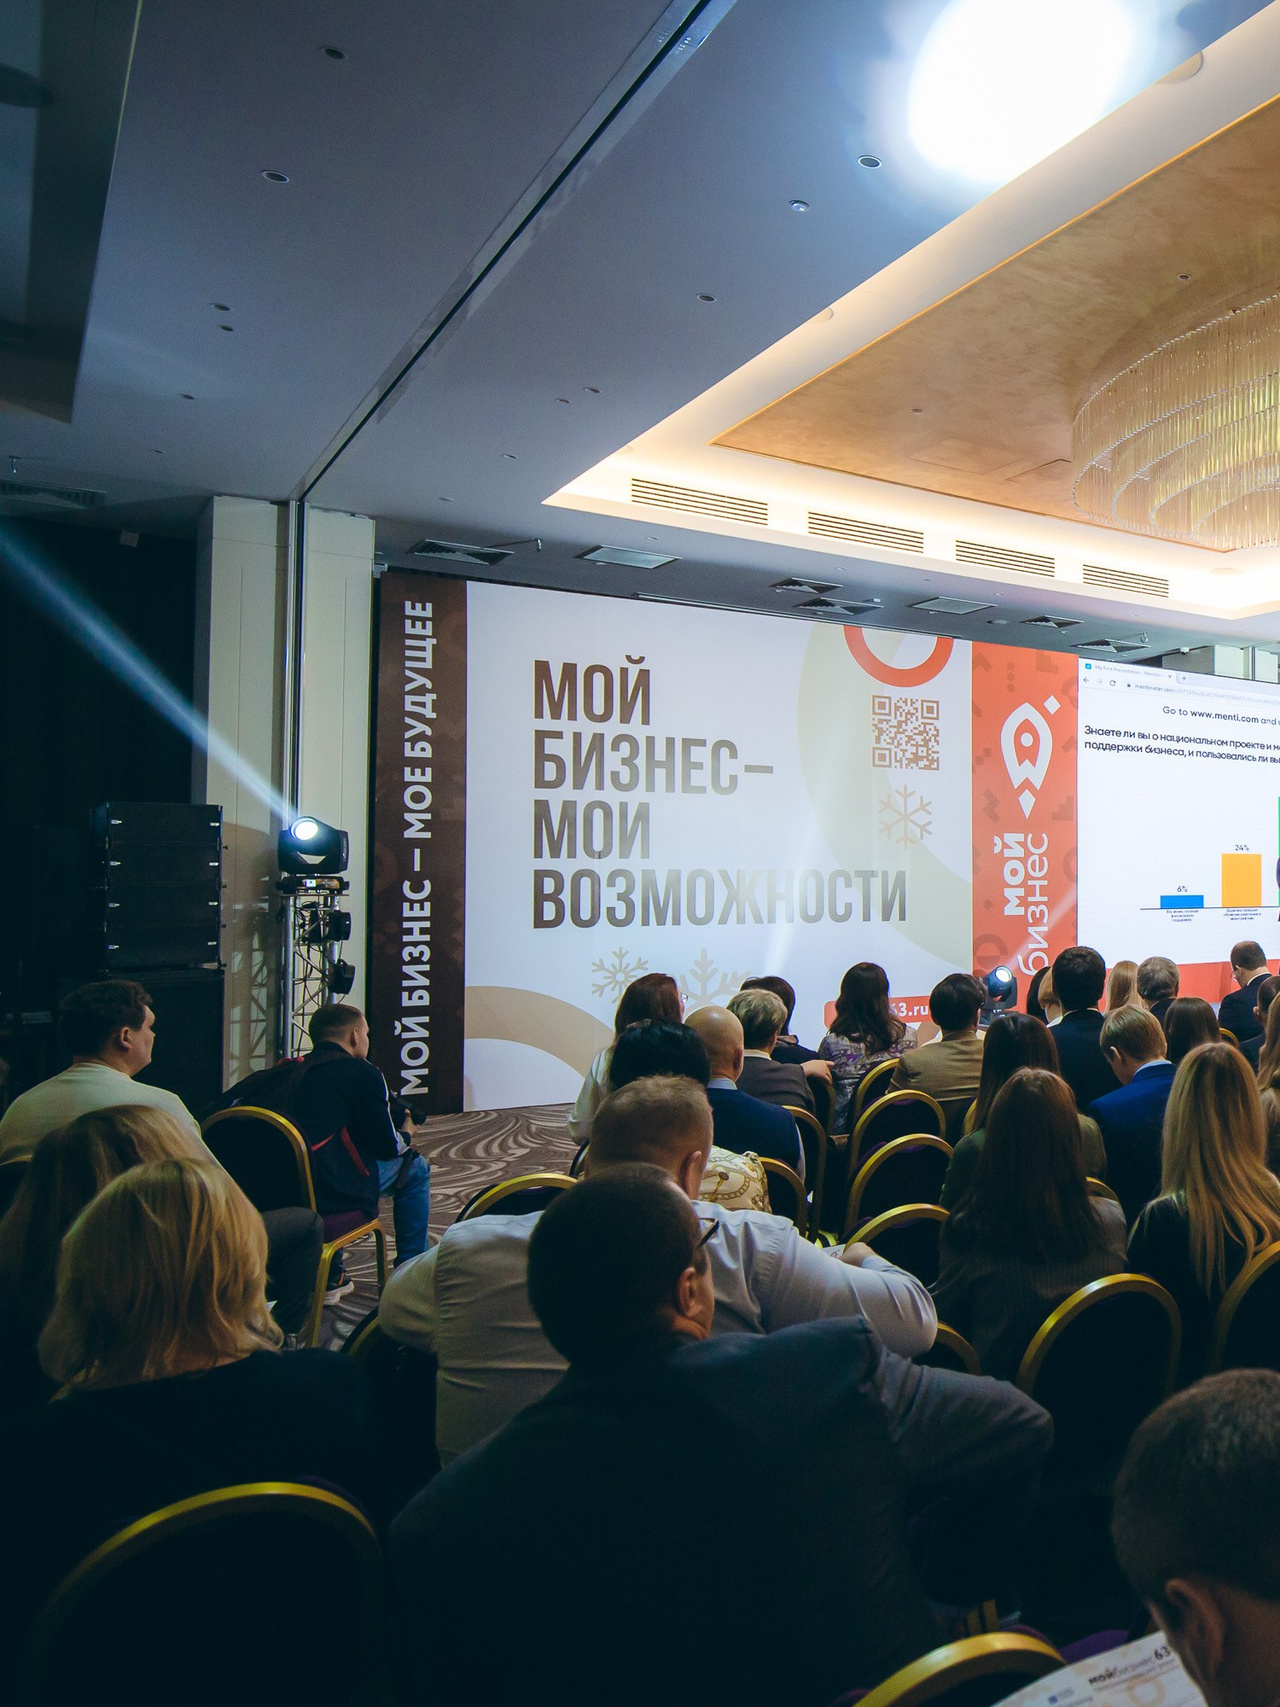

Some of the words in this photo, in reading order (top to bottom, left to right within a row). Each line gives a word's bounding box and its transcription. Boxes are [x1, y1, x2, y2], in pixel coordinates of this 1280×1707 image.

[404, 600, 437, 758] БУДУЩЕЕ
[533, 654, 651, 726] МОЙ
[1084, 725, 1122, 737] Знаете
[1123, 730, 1136, 739] ли
[1137, 732, 1150, 740] вы
[1152, 733, 1159, 741] о
[1160, 733, 1228, 747] национальном
[1229, 739, 1265, 751] проекте
[1266, 743, 1272, 751] и
[1162, 705, 1177, 715] Go
[1178, 707, 1189, 716] to
[1190, 710, 1259, 724] www.menti.com
[1260, 717, 1277, 726] and
[1084, 741, 1143, 754] поддержки
[1144, 744, 1187, 758] бизнеса,
[1188, 749, 1194, 757] и
[1195, 749, 1257, 763] пользовались
[1257, 755, 1268, 763] ли
[403, 766, 432, 838] МОЕ
[533, 799, 650, 859] МОИ
[1234, 844, 1250, 852] 24%
[532, 868, 907, 930] ВОЗМОЖНОСТИ
[1017, 832, 1049, 976] бизнес
[1176, 885, 1188, 893] 6%
[402, 879, 432, 1007] БИЗНЕС
[394, 1016, 429, 1095] МОЙ
[1154, 1646, 1171, 1660] 63
